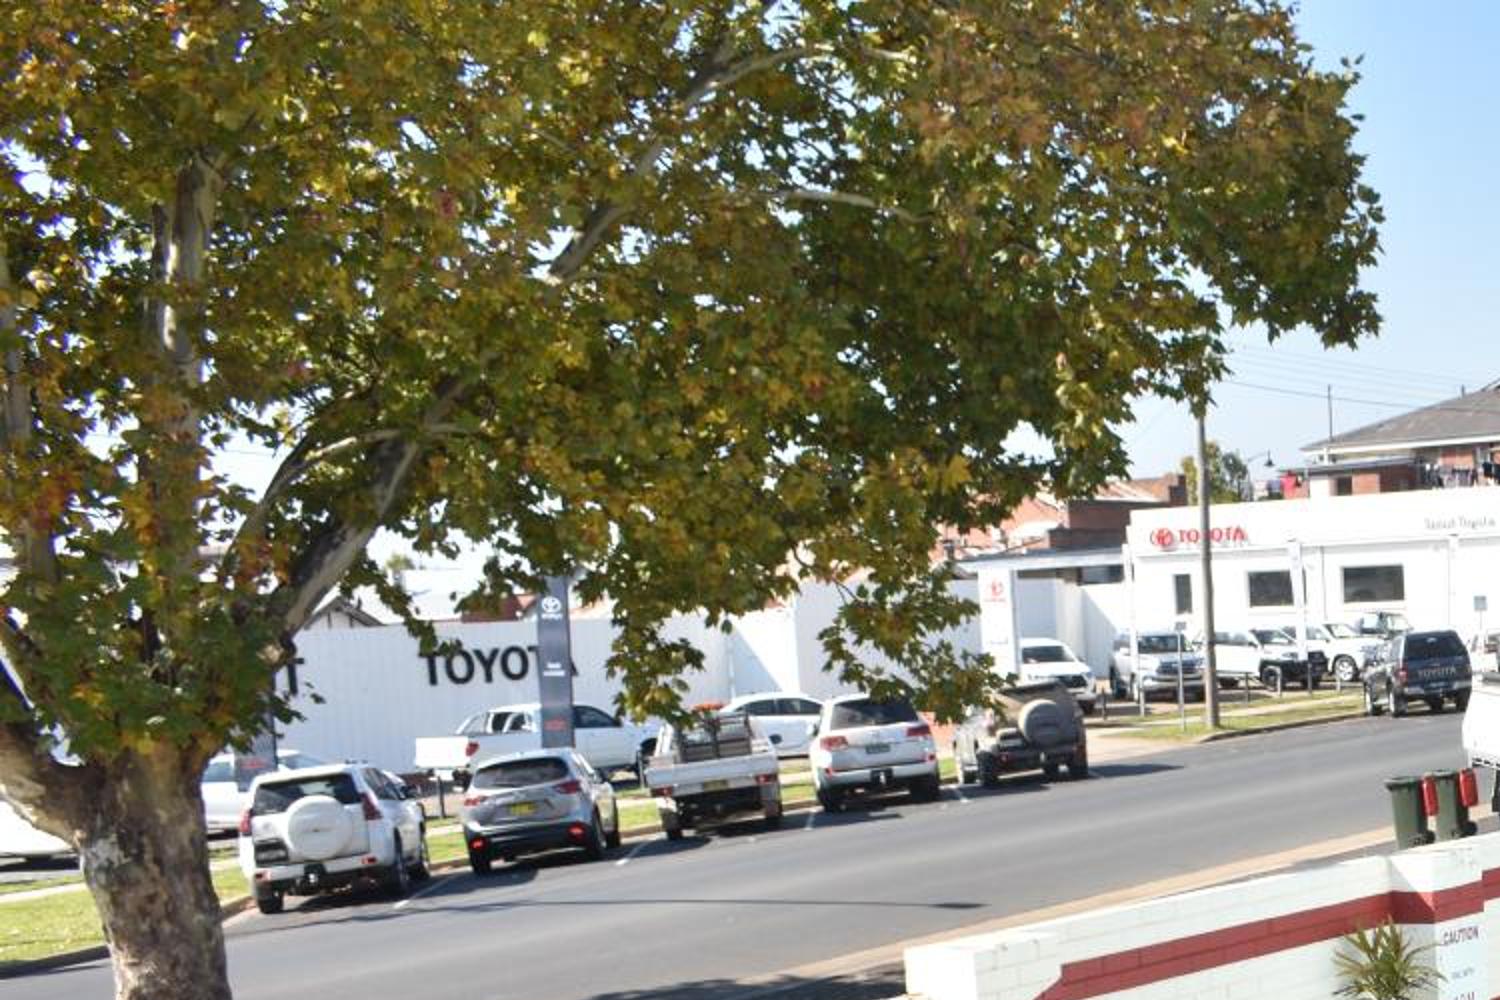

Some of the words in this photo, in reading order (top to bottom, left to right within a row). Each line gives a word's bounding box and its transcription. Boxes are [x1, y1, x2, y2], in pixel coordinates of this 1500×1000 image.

[1178, 525, 1245, 543] TOOTA
[418, 643, 579, 687] TOYO
[1443, 926, 1479, 946] CAUTION
